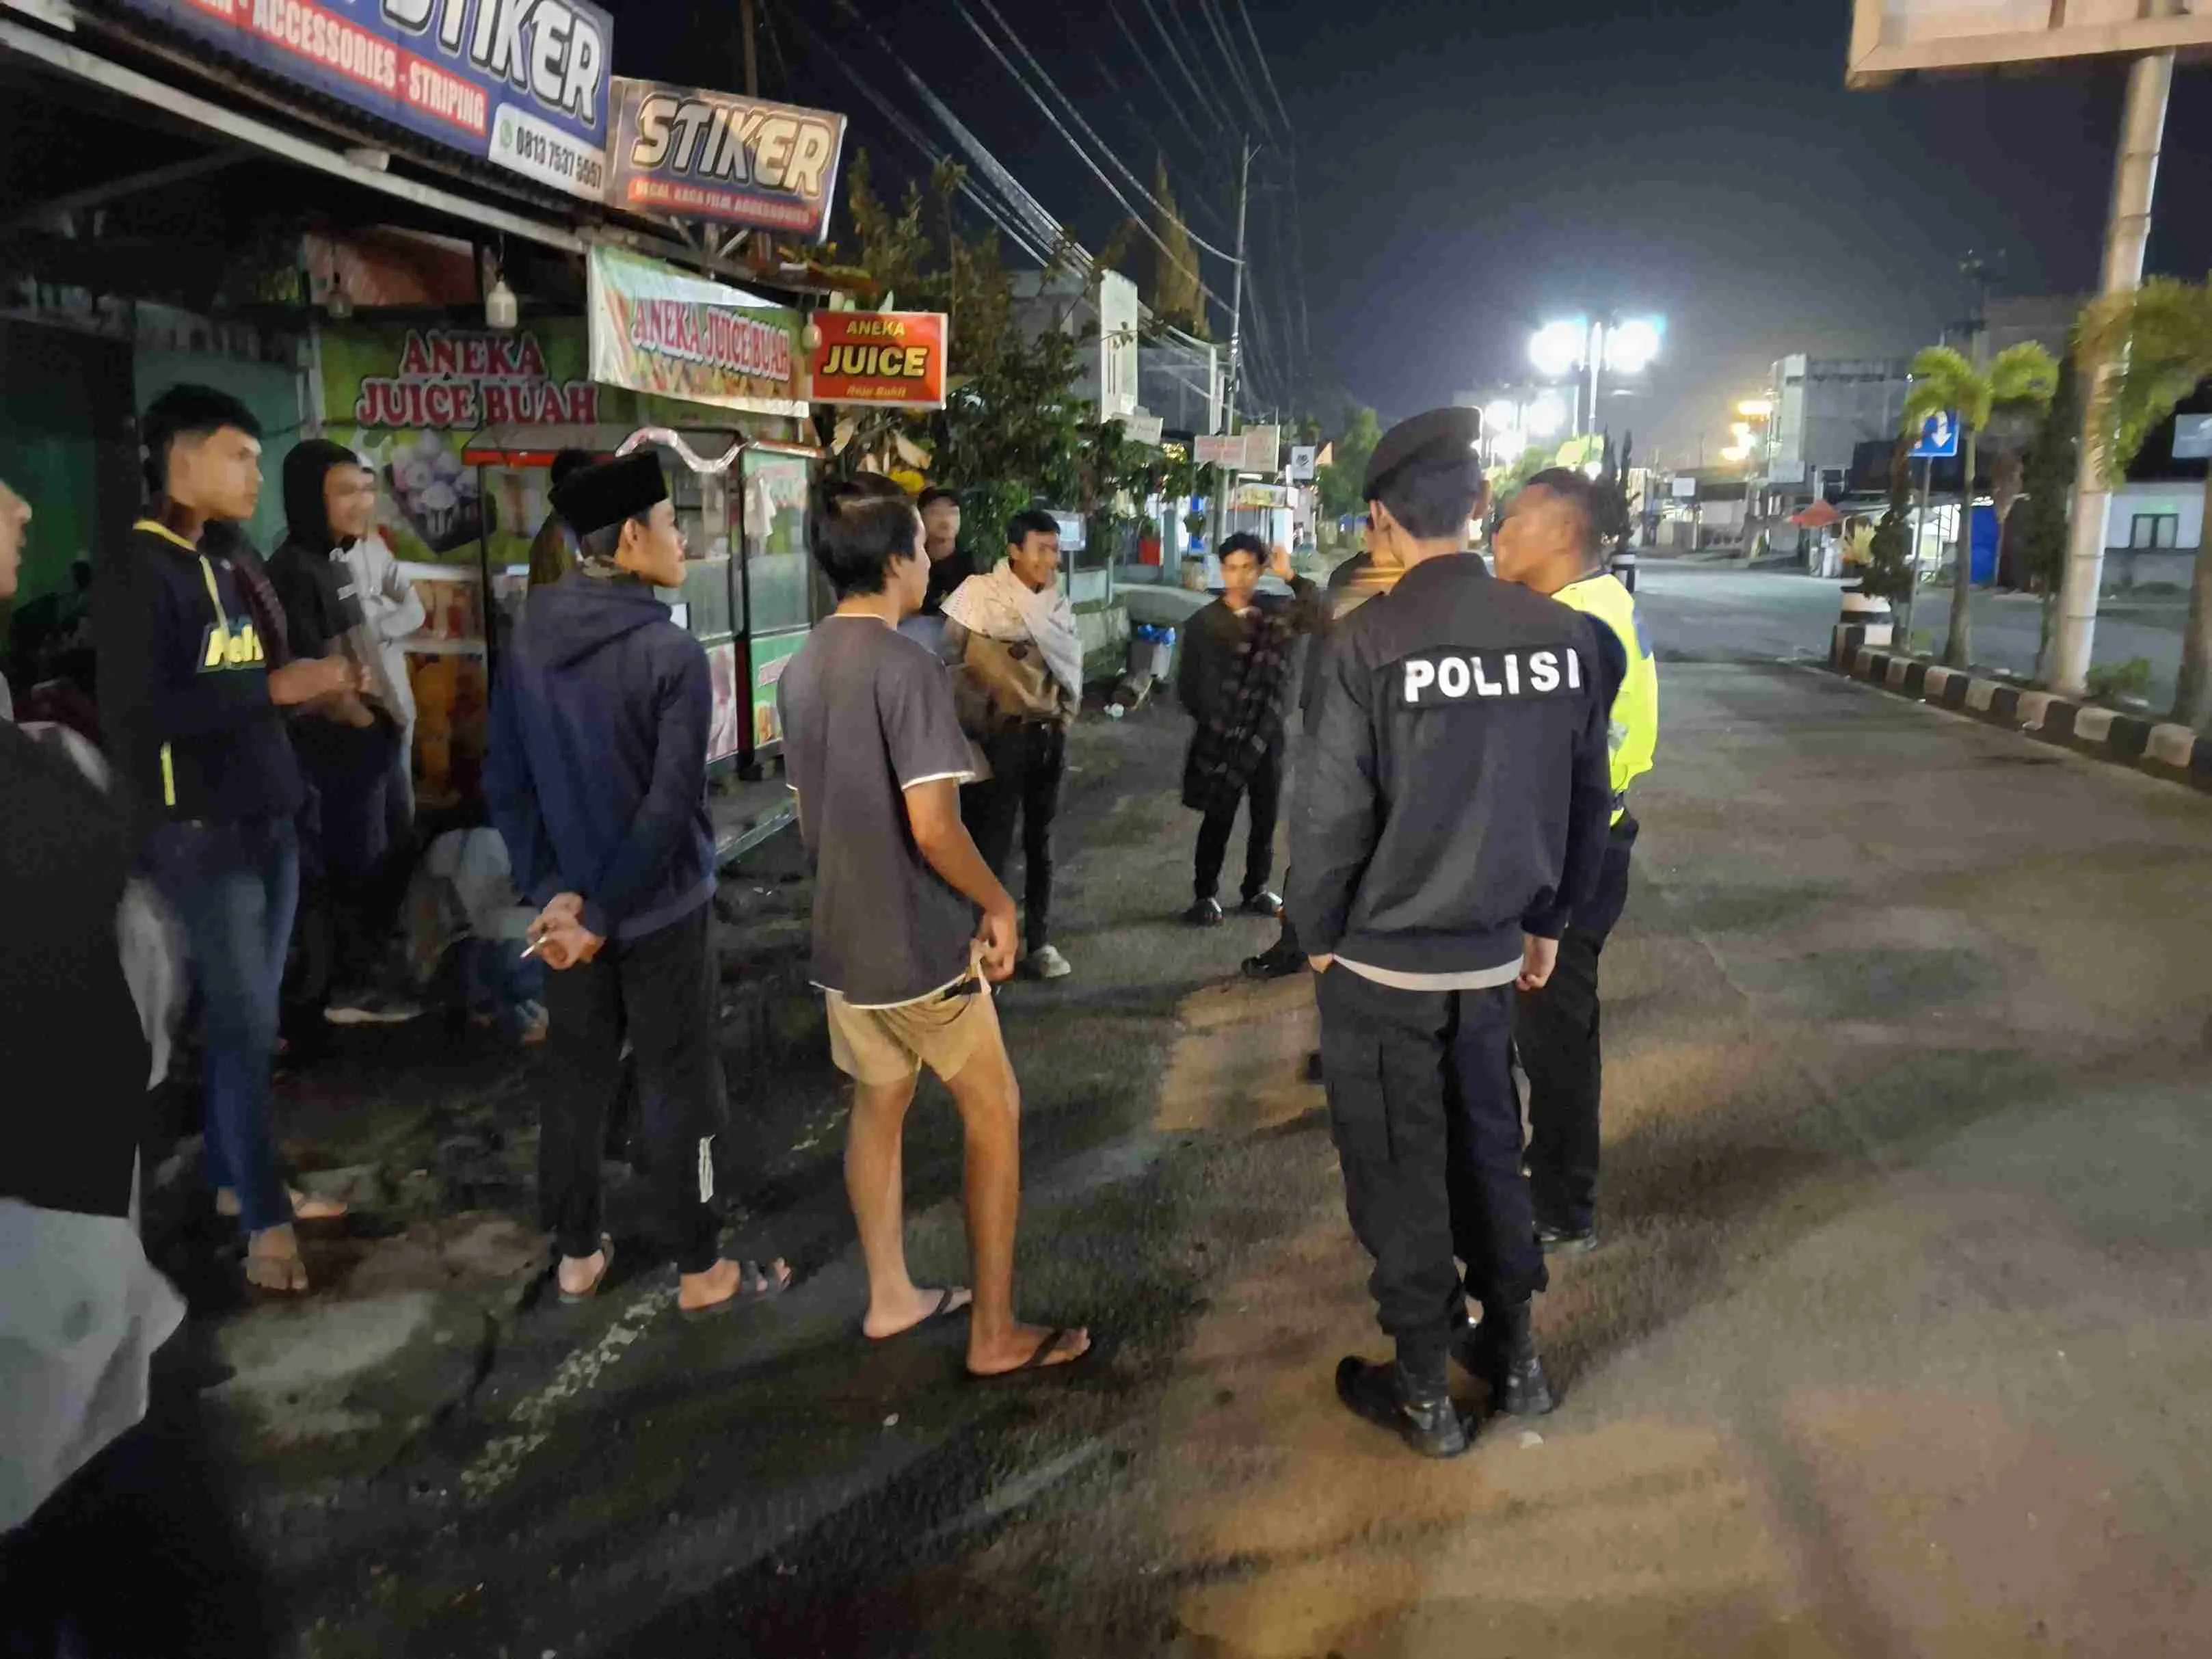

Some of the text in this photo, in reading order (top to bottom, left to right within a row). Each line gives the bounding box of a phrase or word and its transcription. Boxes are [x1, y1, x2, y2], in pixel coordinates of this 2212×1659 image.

[252, 0, 396, 90] ACCESSORIES
[408, 60, 485, 130] STRIPING
[516, 126, 546, 164] 0813
[632, 96, 831, 195] STIKER
[632, 299, 790, 378] ANEKA JUICE BUAH
[847, 320, 906, 336] ANEKA
[401, 331, 547, 377] ANEKA
[822, 345, 928, 376] JUICE
[358, 380, 598, 425] JUICE BUAH
[1404, 647, 1580, 702] POLISI
